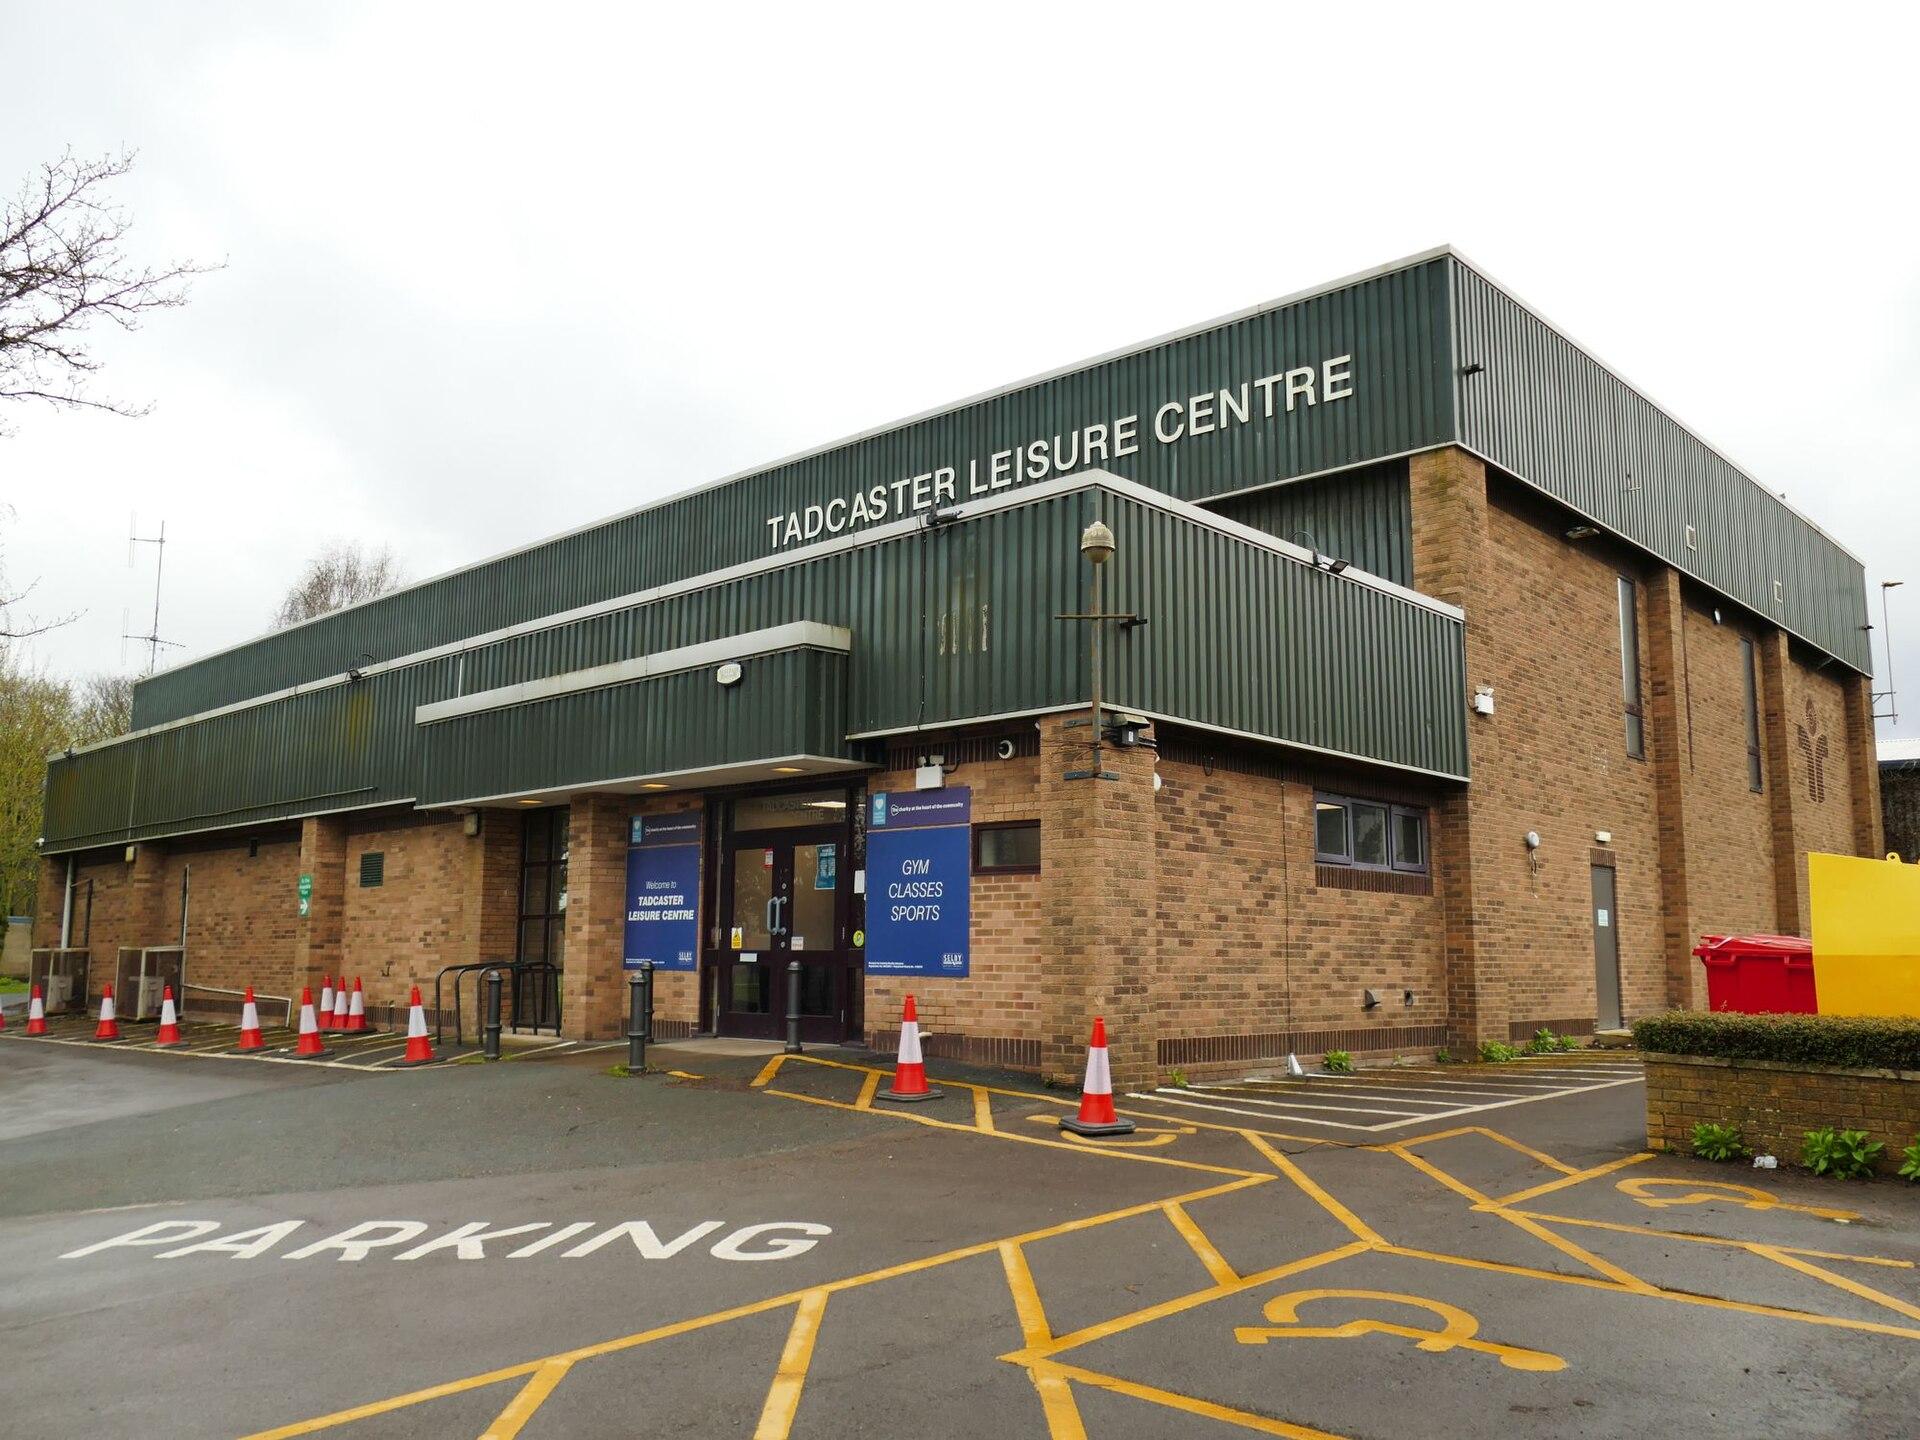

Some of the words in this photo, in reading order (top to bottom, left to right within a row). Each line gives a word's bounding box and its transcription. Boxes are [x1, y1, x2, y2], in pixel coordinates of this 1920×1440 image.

[767, 467, 956, 548] TADCASTER
[969, 415, 1139, 495] LEISURE
[1154, 354, 1353, 443] CENTRE
[902, 859, 930, 875] GYM
[645, 880, 671, 890] Welcome
[671, 880, 677, 889] to
[888, 881, 943, 898] CLASSES
[638, 895, 684, 906] TADCASTER
[628, 910, 661, 921] LEISURE
[661, 909, 695, 920] CENTRE
[891, 905, 940, 921] SPORTS
[943, 954, 963, 962] SELBY
[58, 1219, 833, 1262] PARKING
